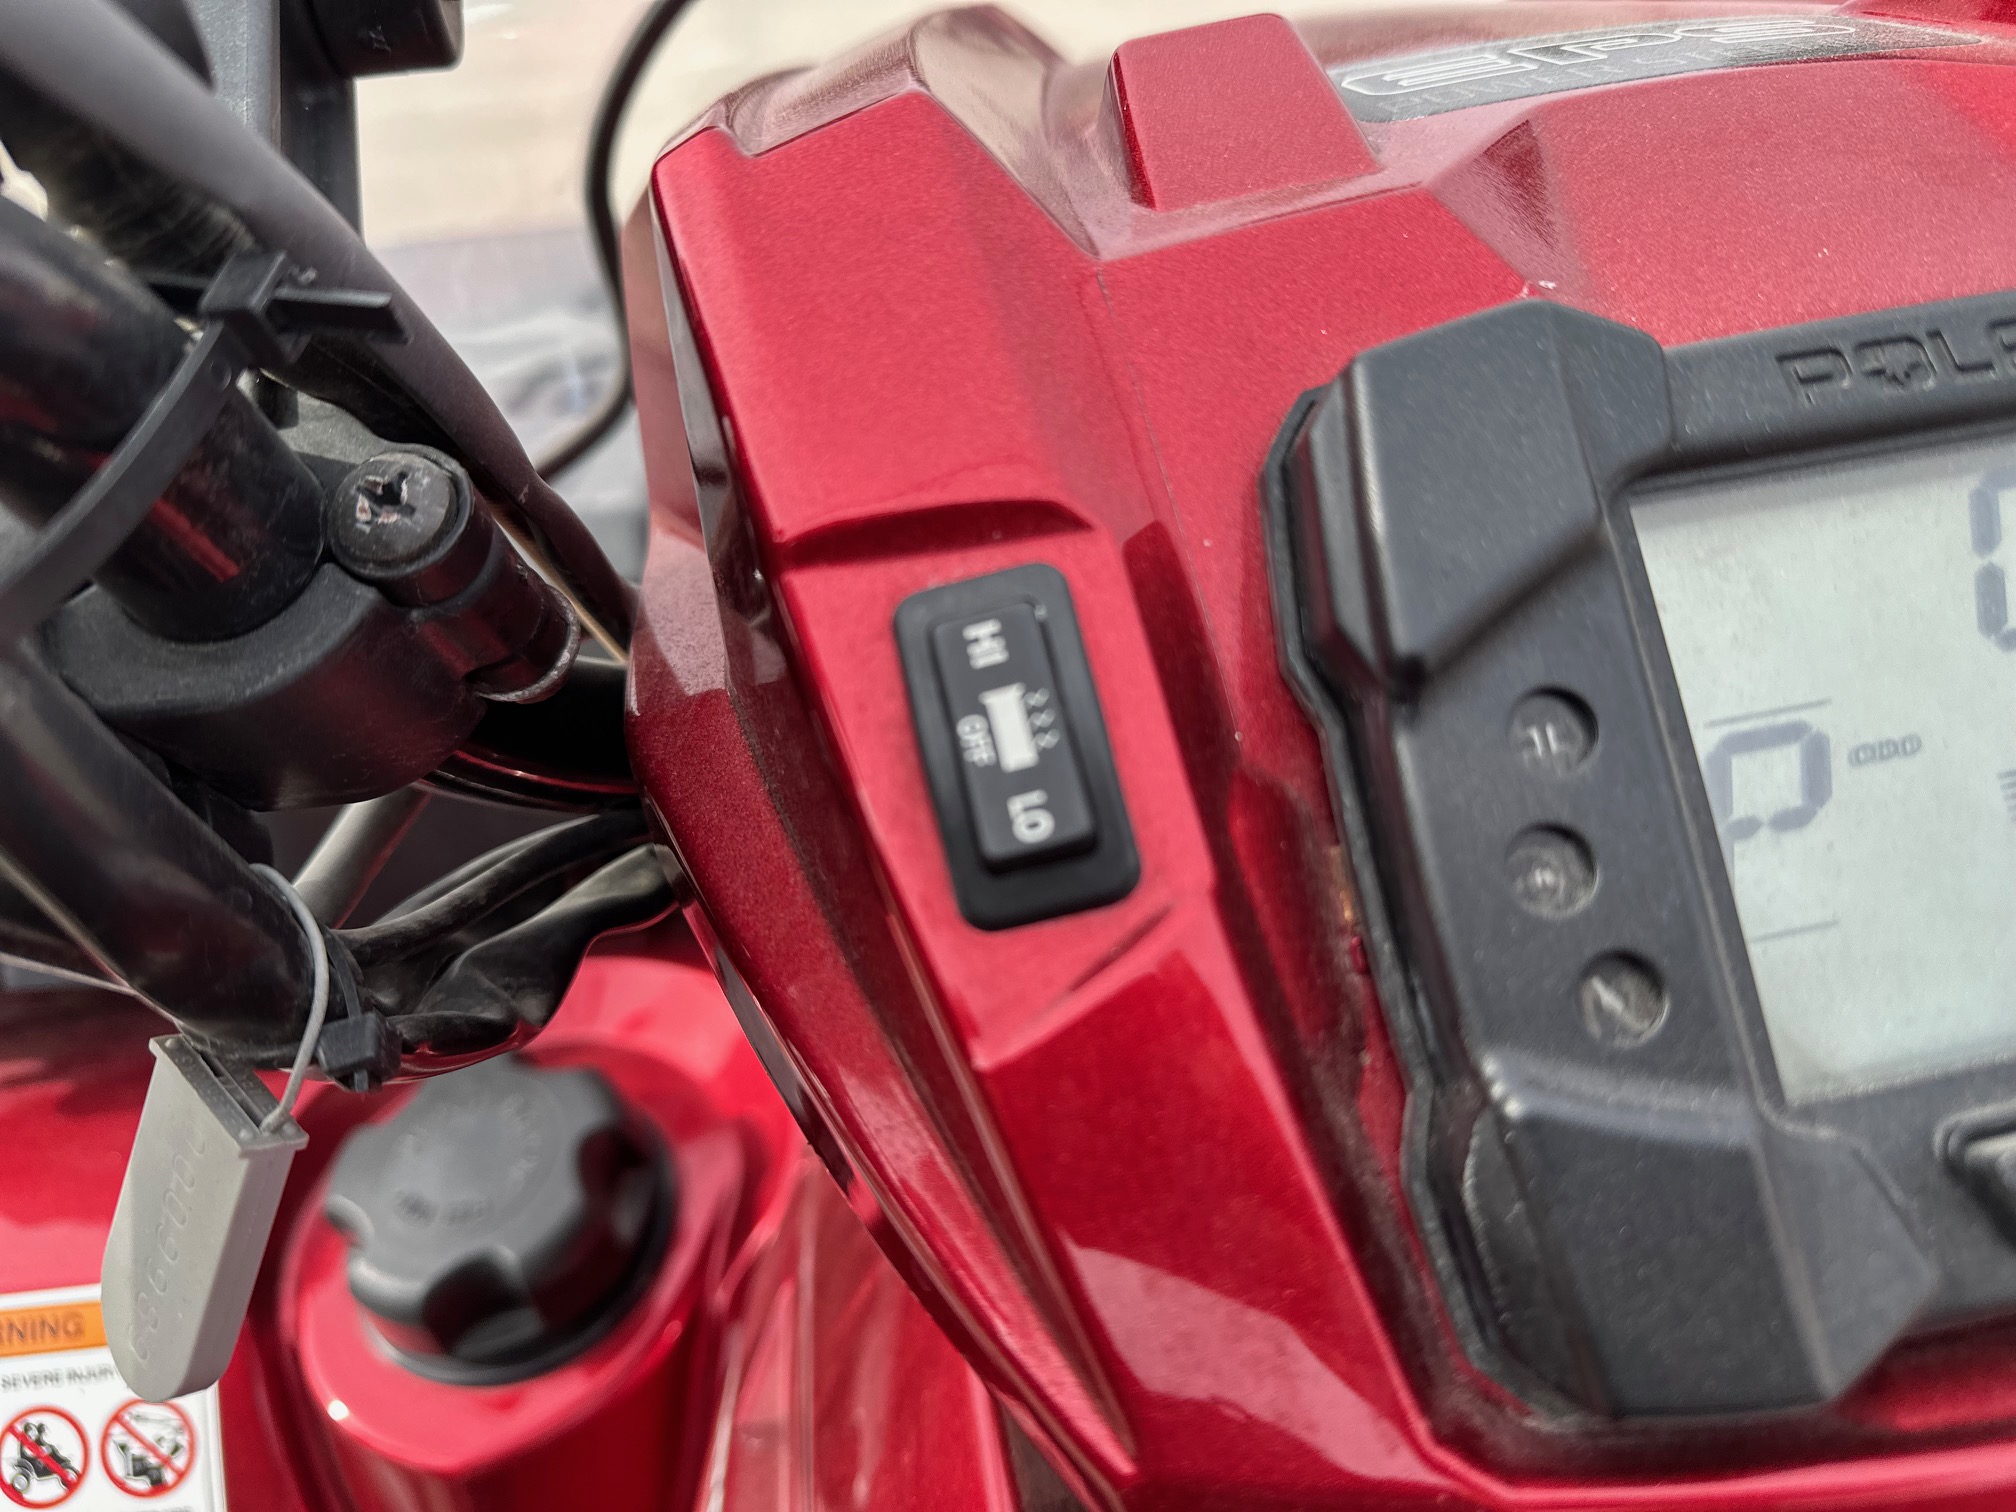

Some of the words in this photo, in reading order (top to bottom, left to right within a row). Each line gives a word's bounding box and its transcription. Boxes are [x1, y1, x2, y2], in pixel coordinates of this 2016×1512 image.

[1341, 20, 1856, 95] EPS
[962, 618, 1010, 670] HI
[956, 713, 998, 767] OFF
[1006, 788, 1056, 844] LO
[0, 1310, 85, 1347] NING
